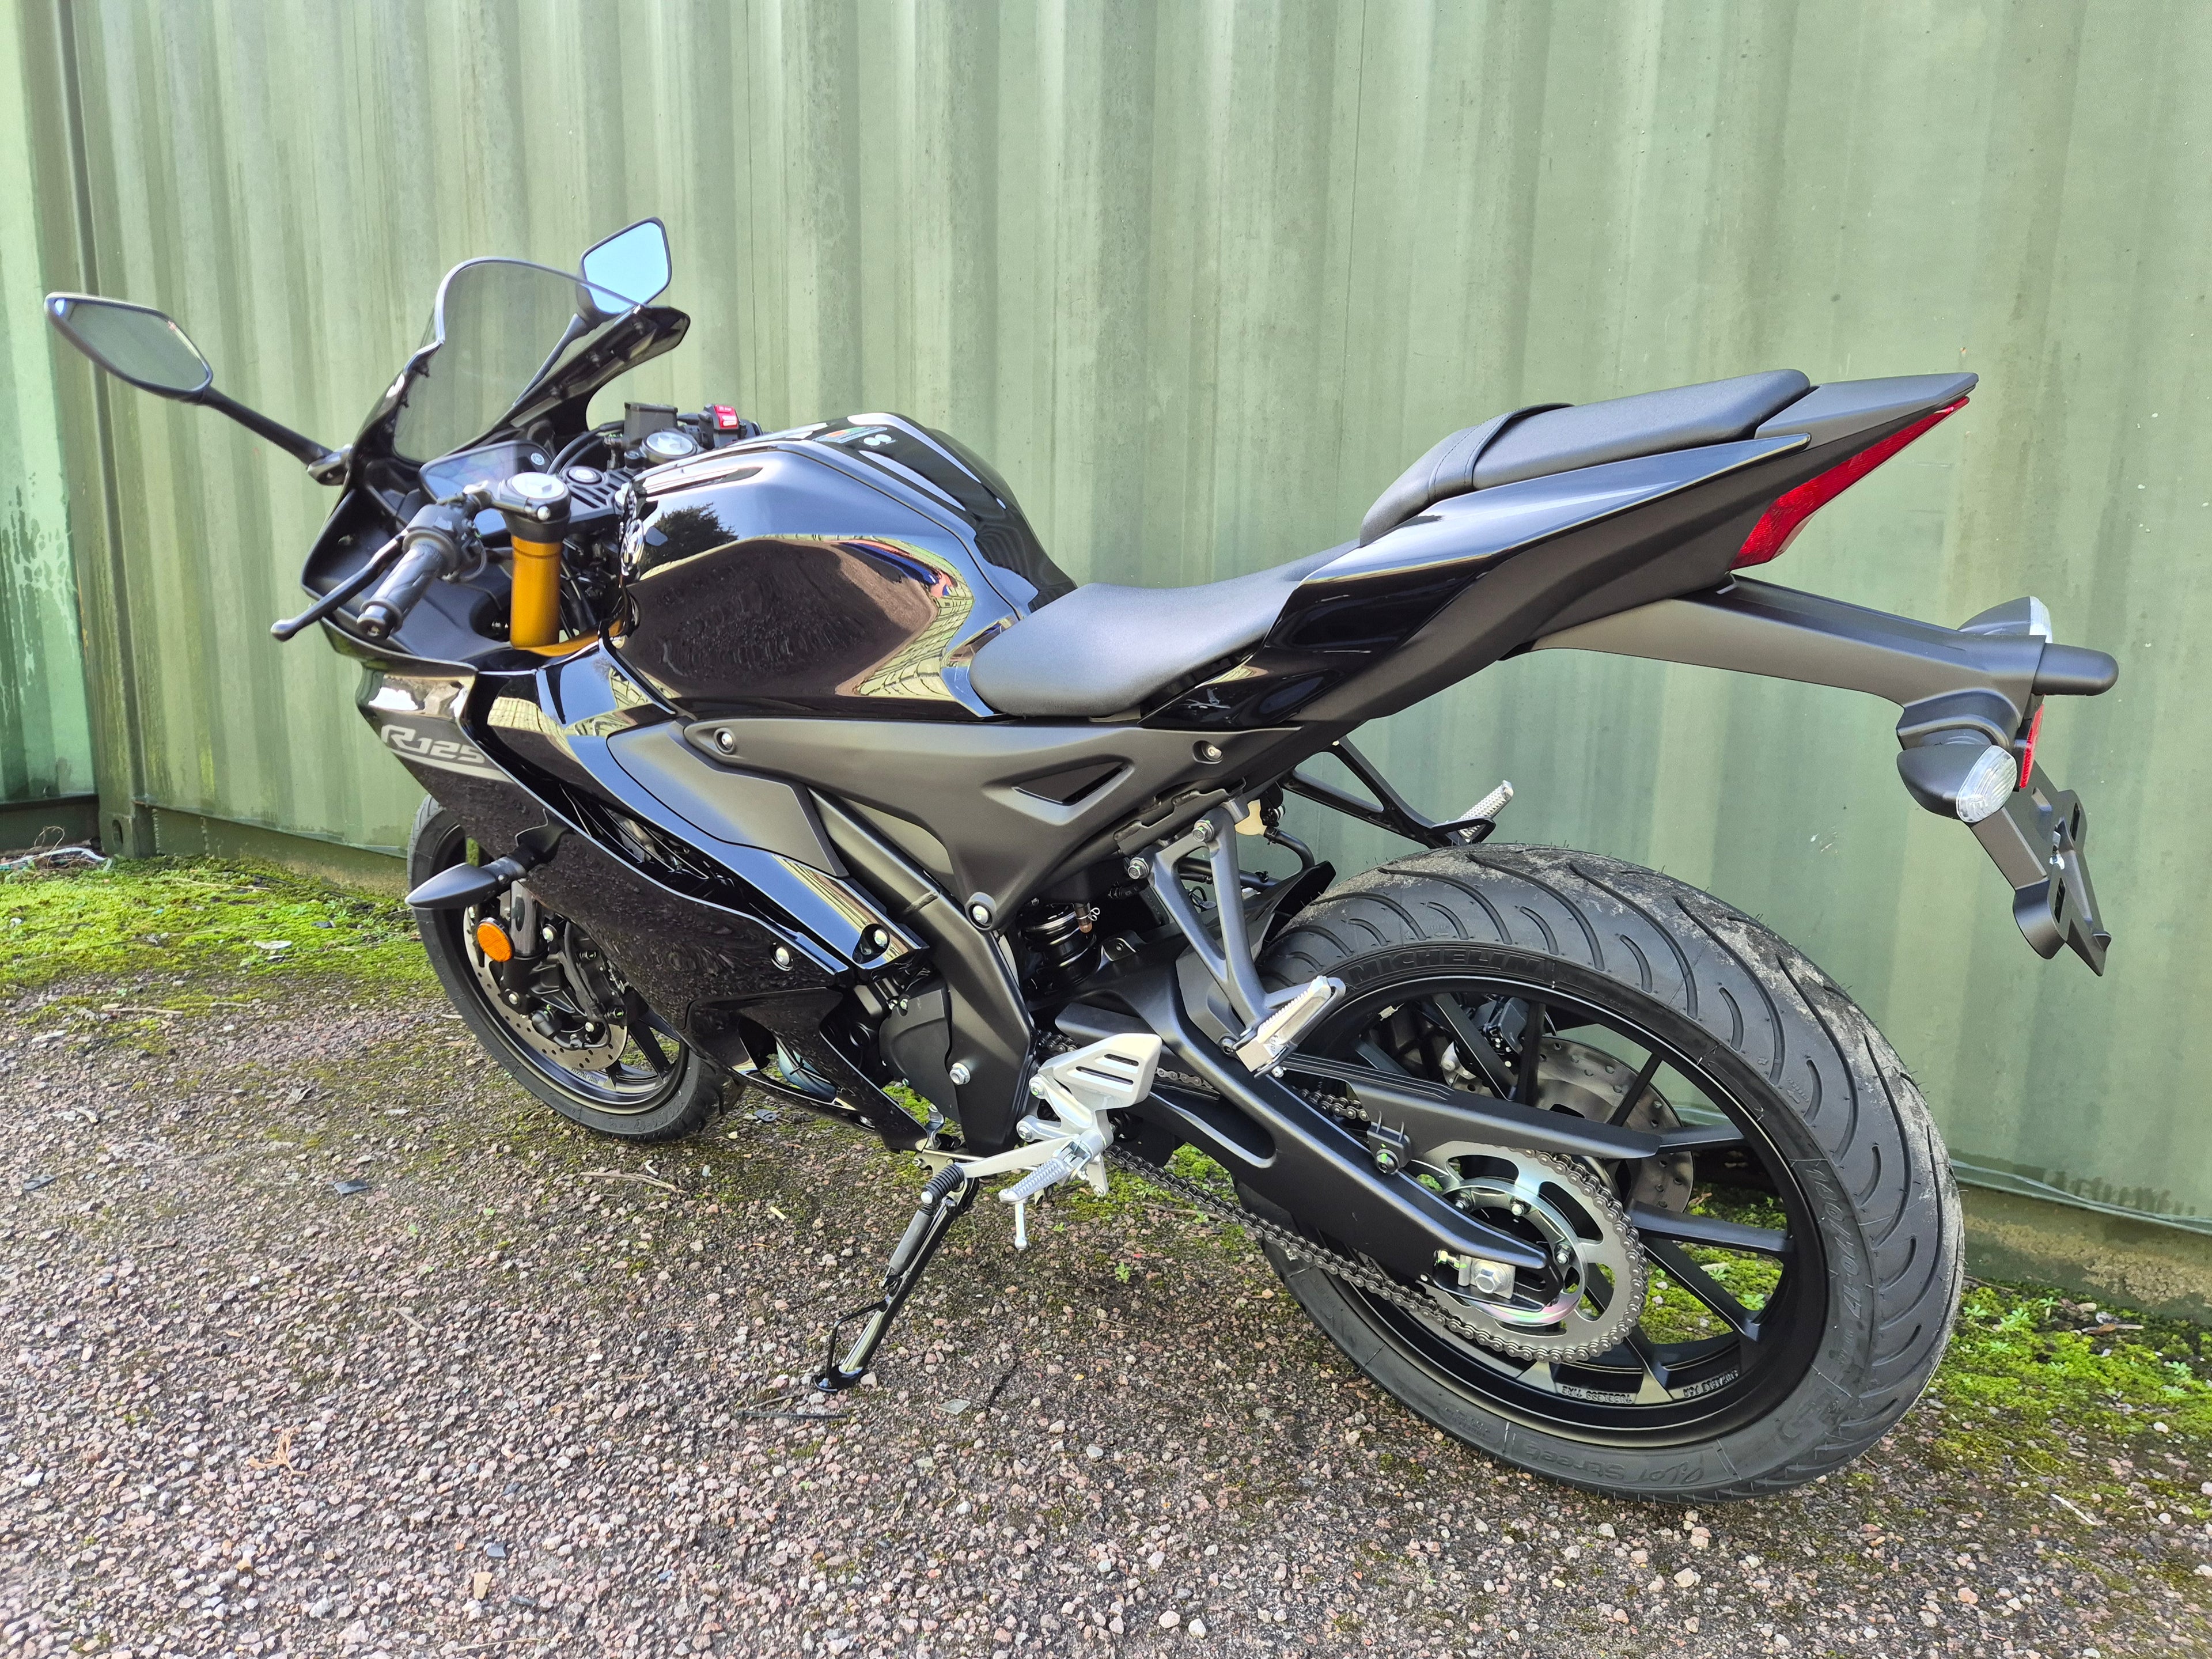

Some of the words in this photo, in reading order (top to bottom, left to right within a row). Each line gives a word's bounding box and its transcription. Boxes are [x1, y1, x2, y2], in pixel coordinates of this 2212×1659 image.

[381, 724, 485, 763] R125
[1348, 949, 1543, 982] MICHELIN
[1585, 1389, 1632, 1404] TUBELESS
[1526, 1442, 1625, 1479] Street
